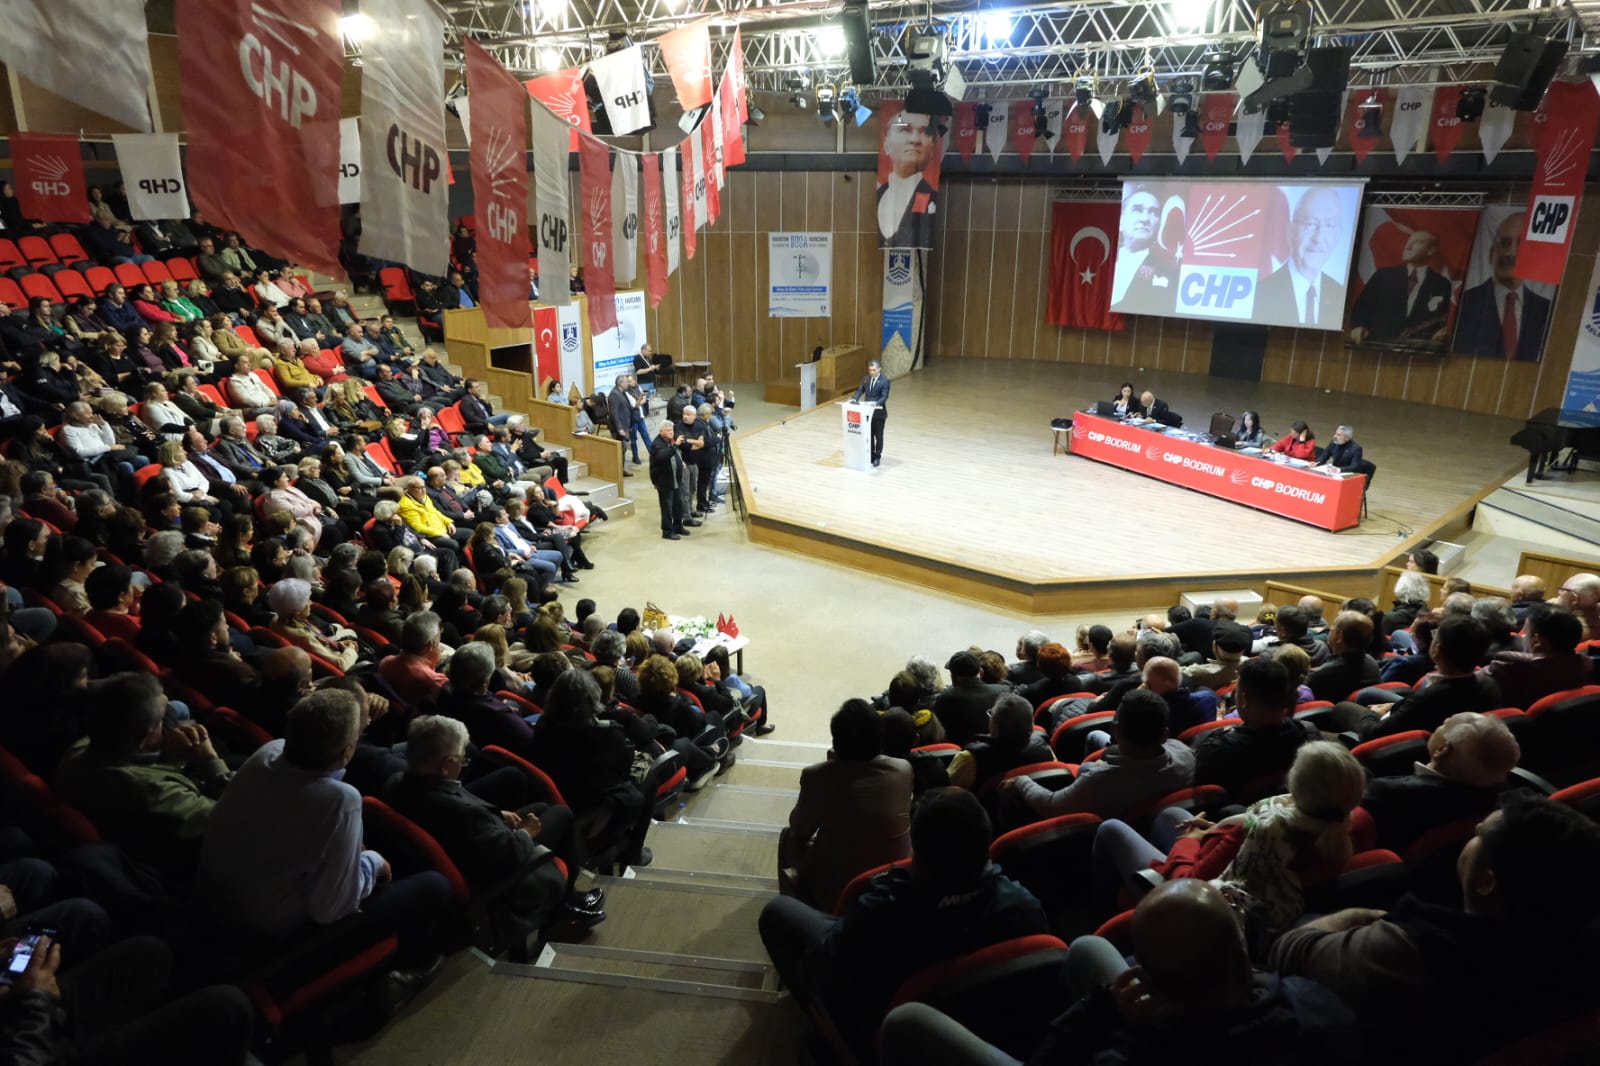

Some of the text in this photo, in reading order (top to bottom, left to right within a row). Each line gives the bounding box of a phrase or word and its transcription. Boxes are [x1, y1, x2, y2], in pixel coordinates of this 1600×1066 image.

[239, 32, 317, 129] CHP
[1401, 102, 1422, 112] CHP
[1069, 124, 1086, 134] CHP
[1129, 124, 1148, 134] CHP
[1206, 122, 1225, 132] CHP
[1439, 117, 1461, 127] CHP
[386, 123, 440, 195] CHP
[487, 201, 518, 245] CHP
[1530, 201, 1569, 235] CHP
[541, 213, 568, 252] CHP
[592, 240, 607, 268] CHP
[1181, 272, 1253, 310] CHP
[1088, 430, 1142, 454] CHP BODRUM
[1163, 452, 1226, 478] CHP BODRUM
[1251, 476, 1325, 505] CHP BODRUM
